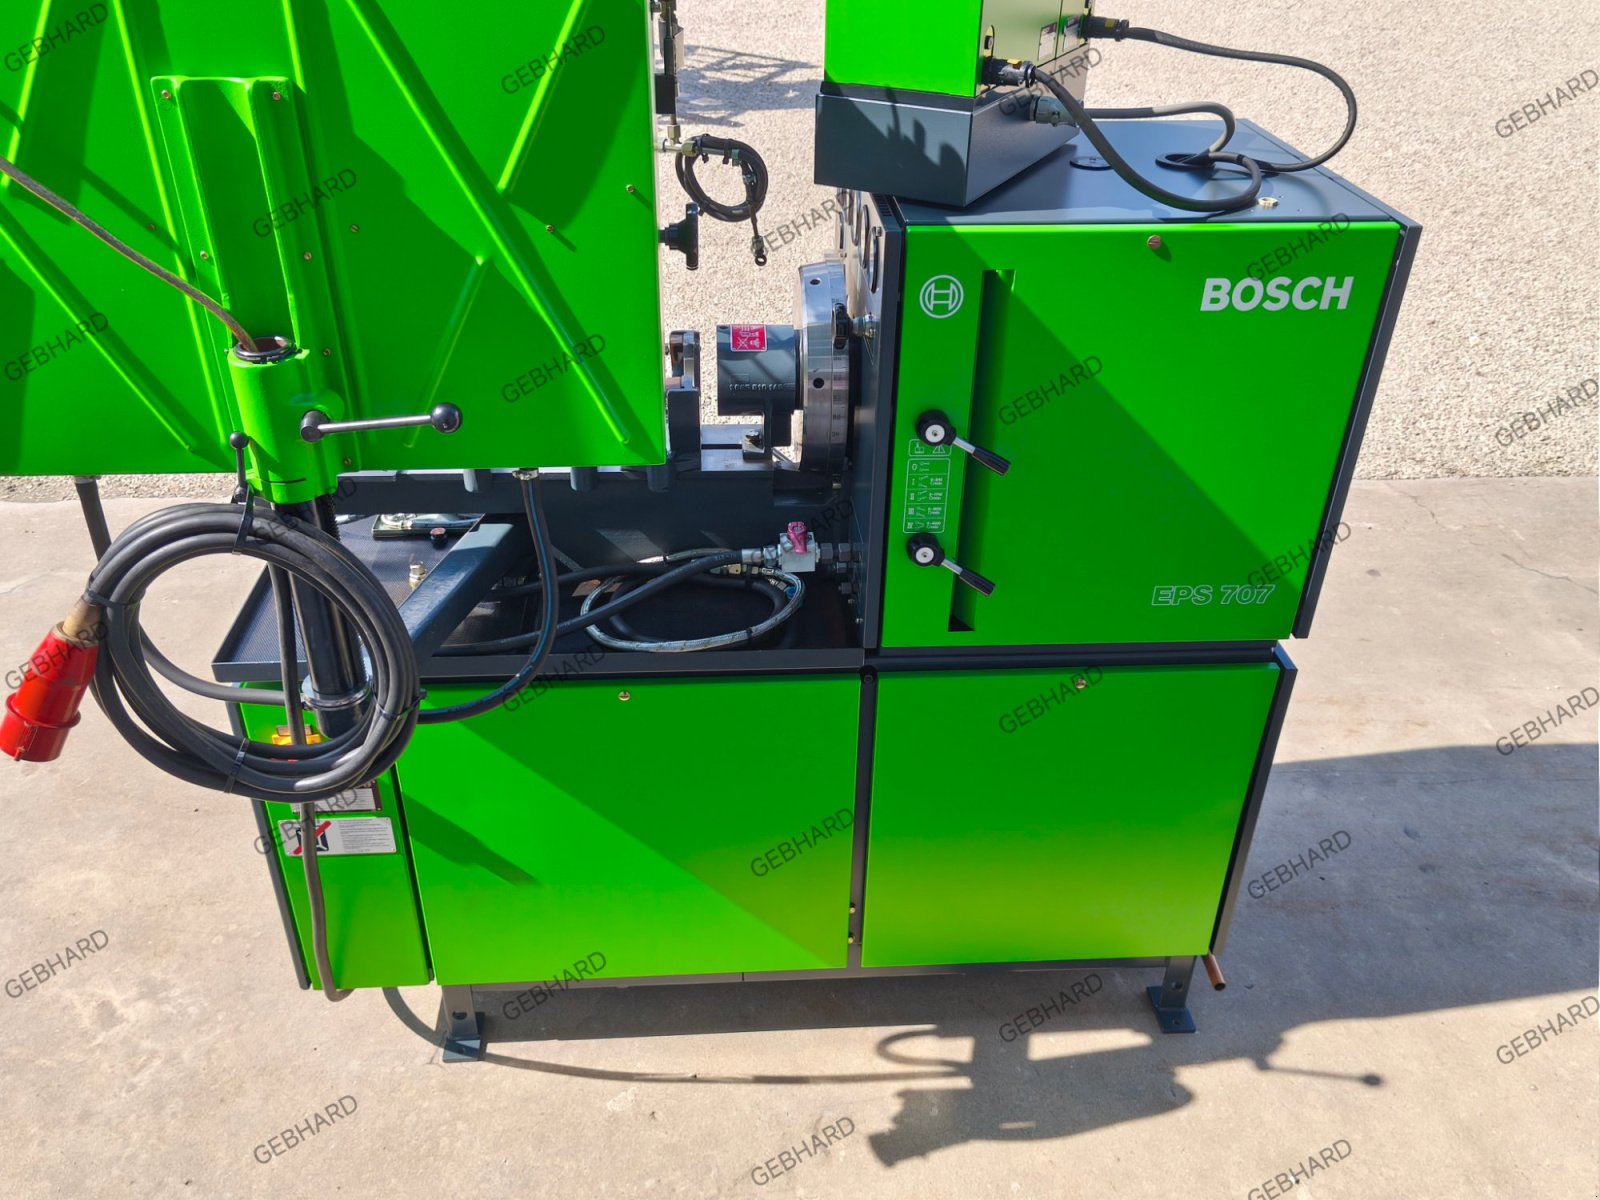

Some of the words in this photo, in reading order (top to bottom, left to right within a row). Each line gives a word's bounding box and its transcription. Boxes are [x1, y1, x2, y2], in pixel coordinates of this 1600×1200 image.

[1200, 276, 1355, 312] BOSCH
[1151, 584, 1213, 606] EPS
[1220, 584, 1276, 604] 707
